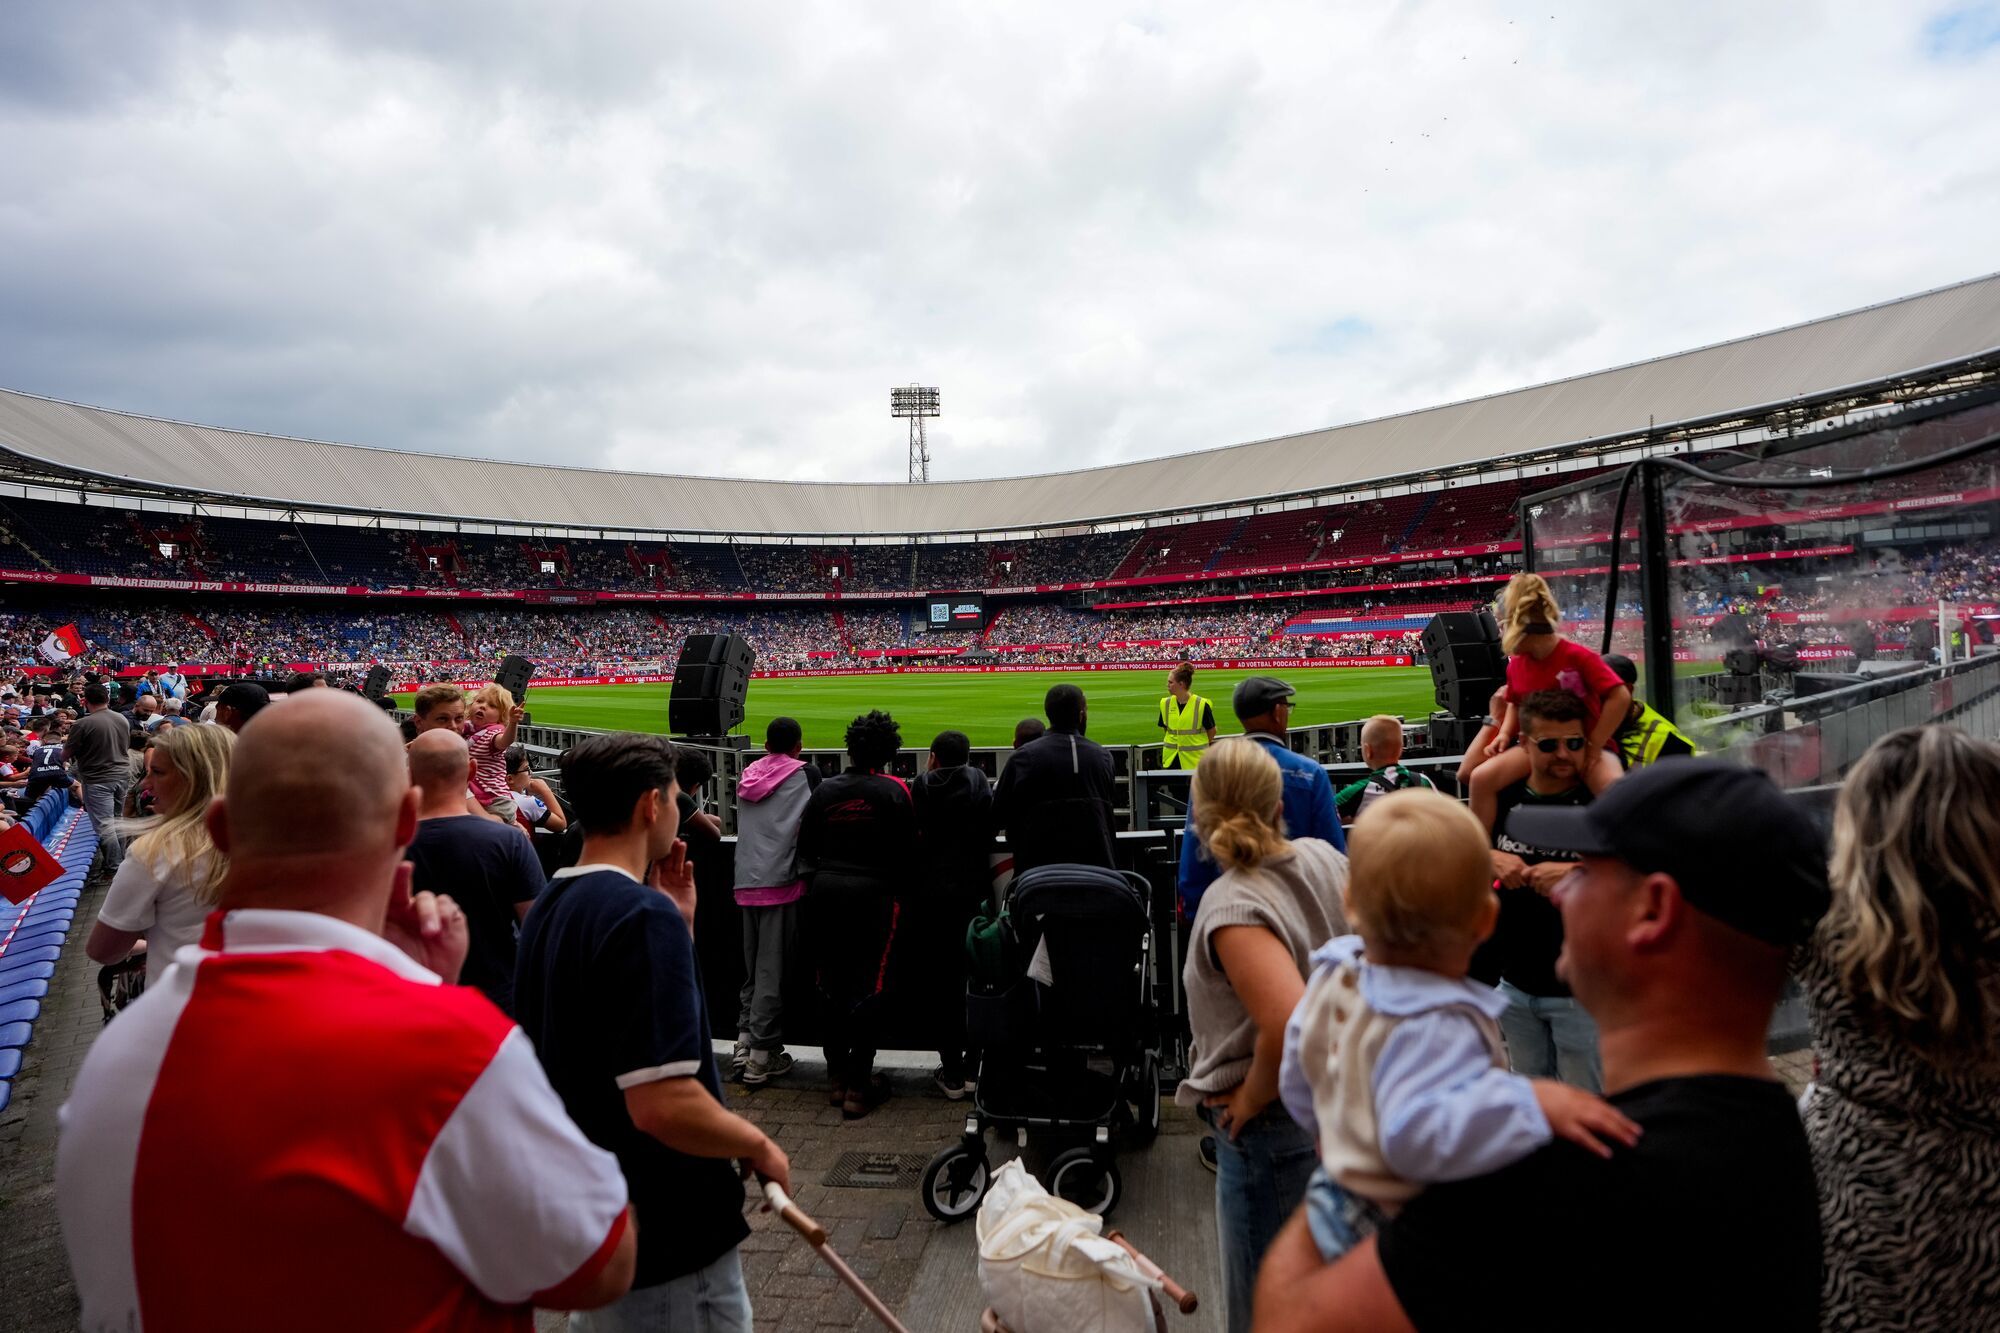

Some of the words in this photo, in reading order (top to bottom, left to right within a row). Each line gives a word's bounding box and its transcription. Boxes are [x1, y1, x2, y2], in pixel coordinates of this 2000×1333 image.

[90, 576, 139, 587] WINNAAR
[140, 579, 192, 589] EUROPACUP
[200, 582, 223, 591] 1970
[244, 583, 255, 592] 14
[255, 584, 278, 592] KEER
[279, 585, 348, 594] BEKERWINNAAR
[1311, 659, 1335, 667] podcast
[1350, 659, 1386, 667] Feyenoord.
[568, 678, 600, 686] Feyenoord.
[43, 748, 53, 765] 7
